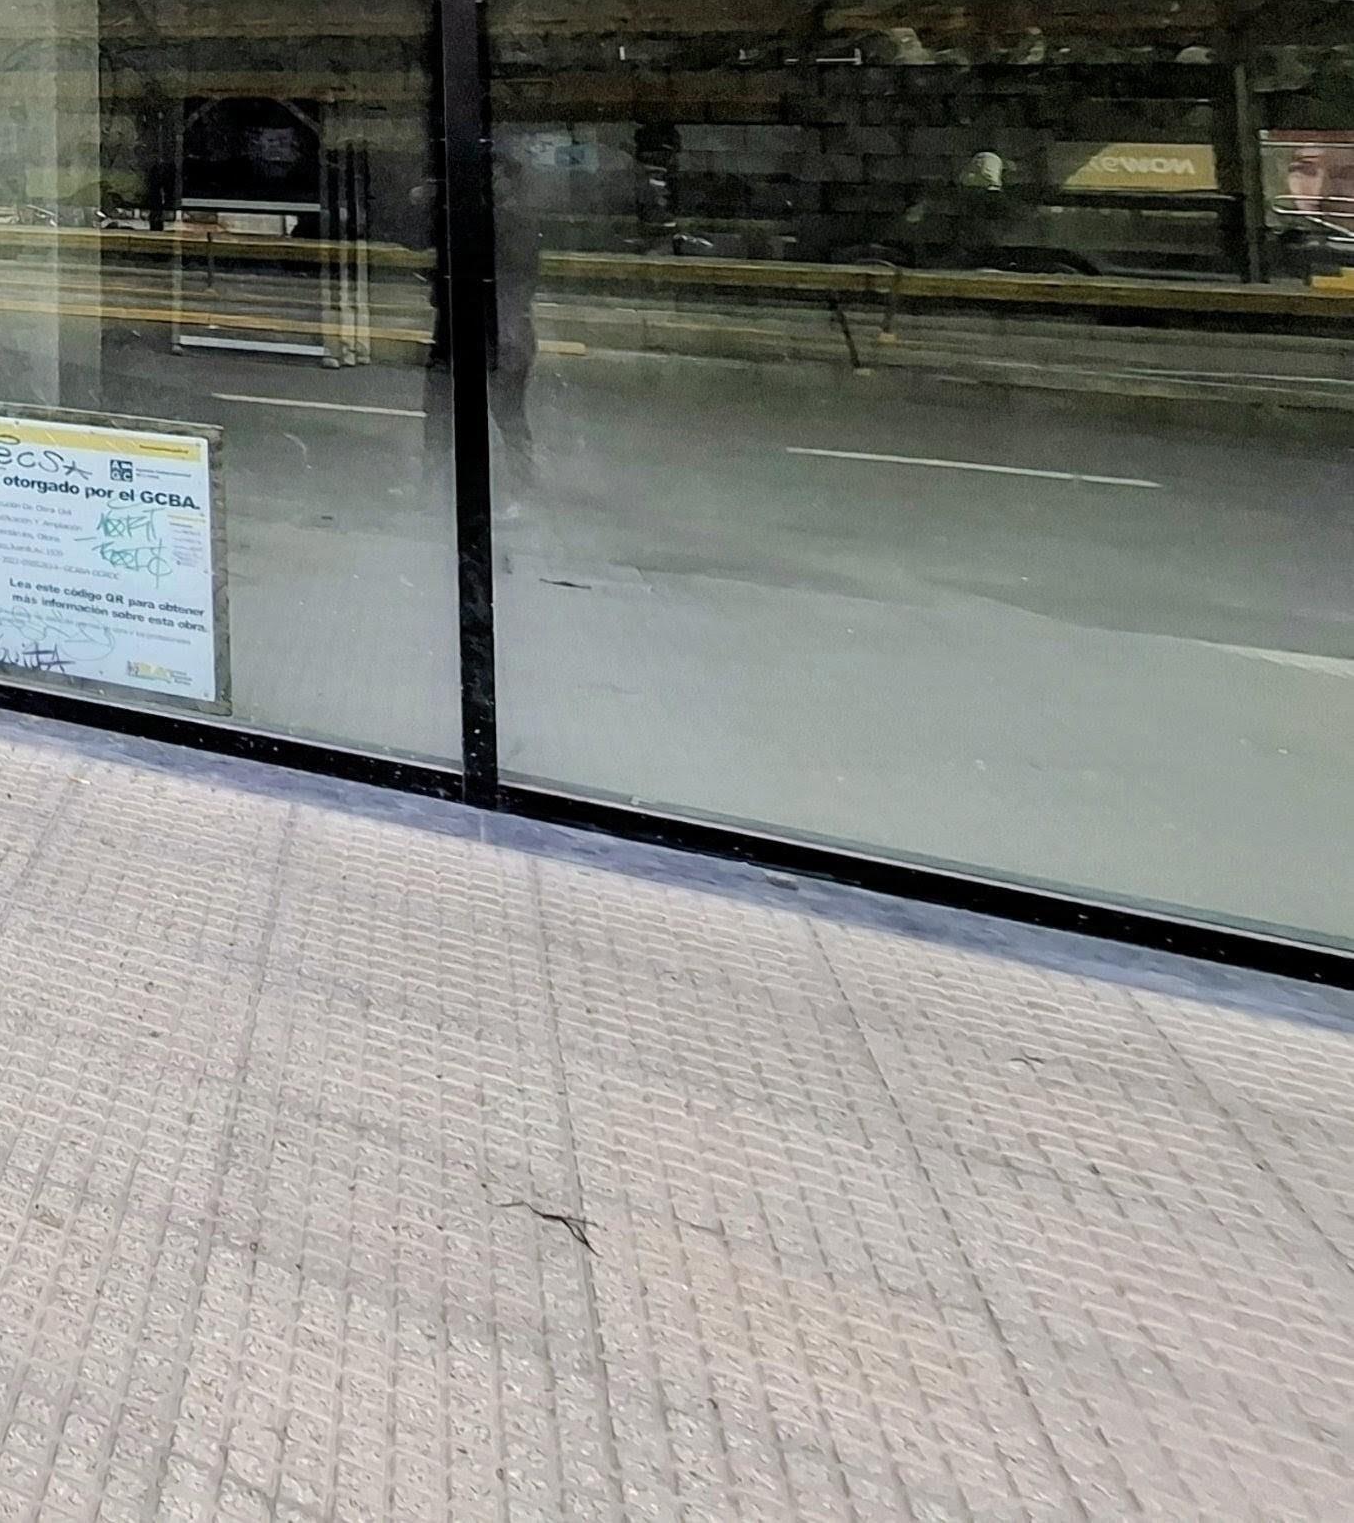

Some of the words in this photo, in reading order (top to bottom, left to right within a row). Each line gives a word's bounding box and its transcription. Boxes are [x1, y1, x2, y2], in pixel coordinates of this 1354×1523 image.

[3, 475, 80, 496] otorgado
[85, 486, 114, 500] por
[118, 488, 135, 502] el
[140, 490, 201, 510] GCBA.
[9, 577, 33, 590] Lea
[35, 582, 61, 595] este
[63, 585, 103, 602] código
[105, 591, 125, 605] QR
[128, 597, 155, 610] para
[158, 600, 206, 617] obtener
[12, 592, 38, 606] más
[42, 597, 109, 616] información
[112, 608, 145, 623] sobre
[148, 614, 175, 628] esta
